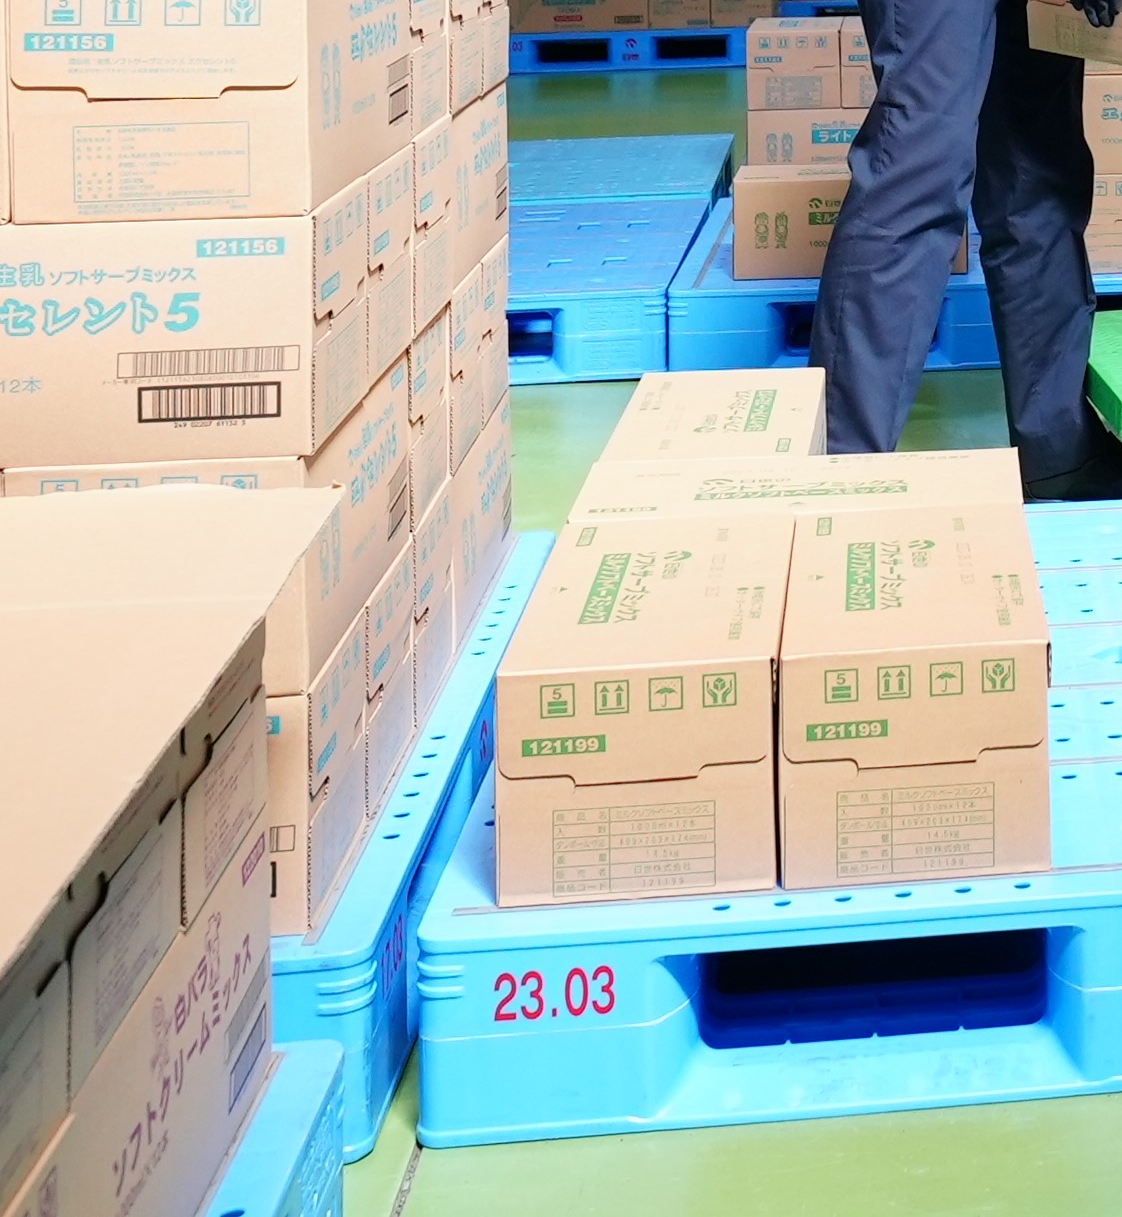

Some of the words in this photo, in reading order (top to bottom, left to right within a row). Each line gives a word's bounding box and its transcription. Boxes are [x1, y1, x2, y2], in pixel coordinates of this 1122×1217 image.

[30, 35, 107, 50] 121156
[202, 239, 279, 255] 121156
[50, 266, 197, 285] ソフトサーブミックス
[881, 540, 906, 611] ソフトサーブミックス
[614, 551, 657, 624] ソフトサーブミックス
[836, 673, 846, 685] 5
[552, 687, 562, 700] 5
[813, 721, 882, 739] 121199
[528, 737, 600, 755] 121199
[494, 965, 615, 1021] 23.03
[113, 933, 252, 1198] ソフトクリームミックス
